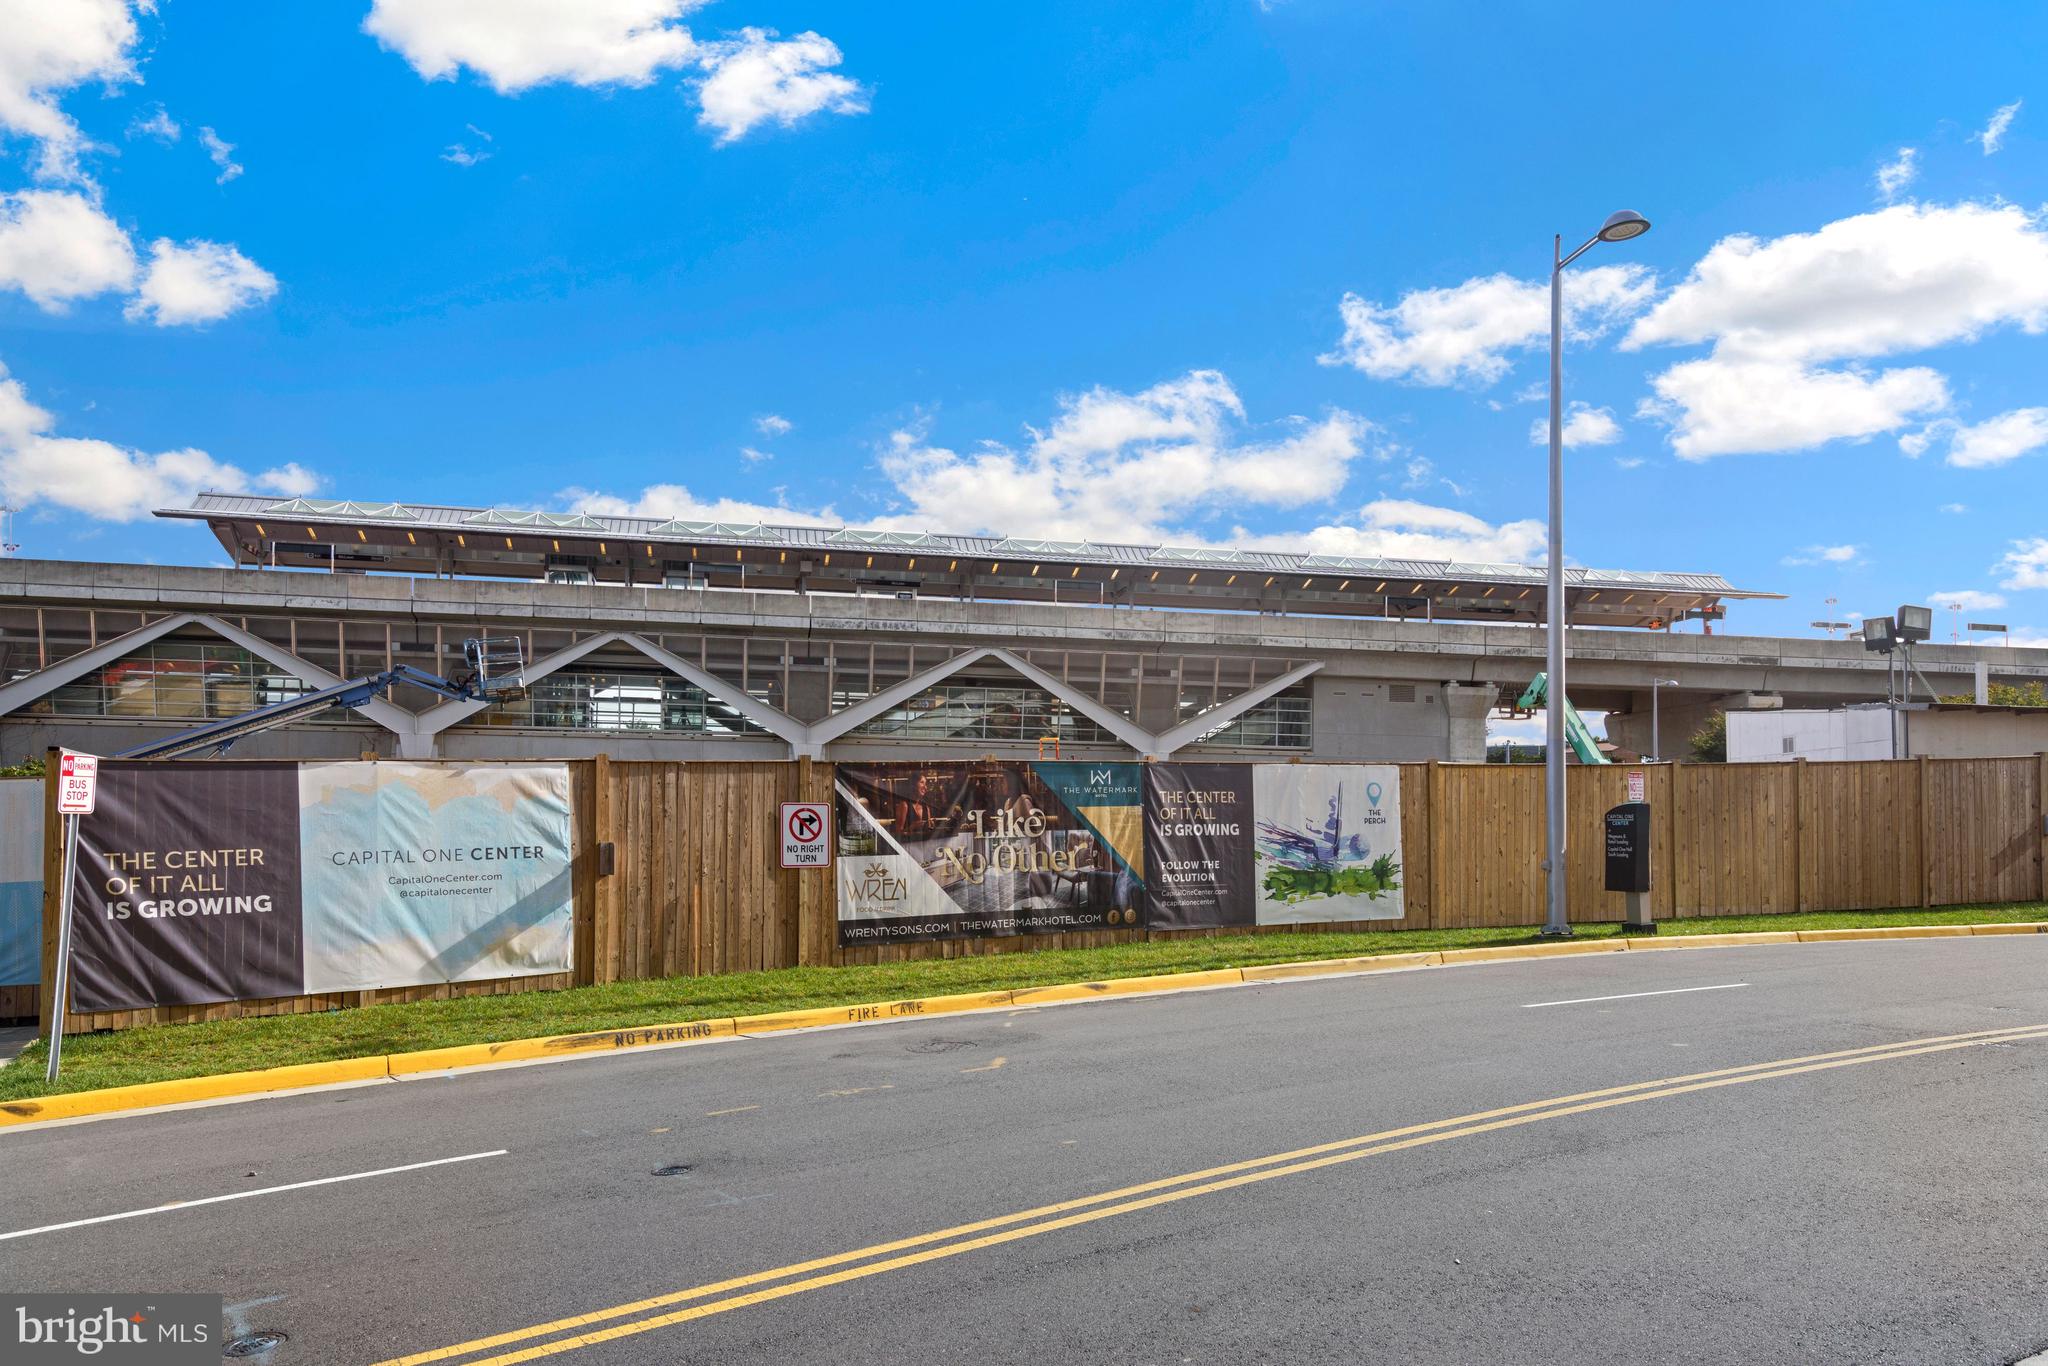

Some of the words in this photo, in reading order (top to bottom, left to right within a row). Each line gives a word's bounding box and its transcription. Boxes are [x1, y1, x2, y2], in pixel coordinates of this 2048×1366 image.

[63, 760, 74, 771] NO
[75, 763, 95, 771] PARKING
[69, 780, 87, 789] BUS
[1063, 786, 1080, 794] THE
[1084, 786, 1137, 794] WATERMARK
[66, 791, 88, 800] STOP
[1159, 791, 1183, 803] THE
[1186, 791, 1236, 803] CENTER
[1160, 808, 1177, 820] OF
[1180, 808, 1191, 820] IT
[1194, 808, 1216, 820] ALL
[967, 808, 1046, 839] Like
[1160, 824, 1172, 836] IS
[1174, 823, 1240, 836] GROWING
[786, 845, 799, 853] NO
[800, 845, 824, 853] RIGHT
[103, 852, 156, 871] THE
[164, 848, 264, 869] CENTER
[332, 850, 416, 866] CAPITAL
[422, 848, 464, 863] ONE
[470, 846, 545, 861] CENTER
[795, 855, 817, 863] TURN
[935, 845, 987, 885] No
[992, 841, 1089, 874] Other
[1161, 861, 1200, 870] FOLLOW
[1202, 860, 1220, 869] THE
[388, 873, 503, 886] CapitalOneCenter.com
[1162, 872, 1215, 883] EVOLUTION
[105, 876, 142, 896] OF
[150, 874, 173, 894] IT
[180, 874, 224, 892] ALL
[845, 878, 907, 902] WREN
[400, 886, 493, 900] @capitalonecenter
[1161, 889, 1228, 898] CapitalOneCenter.com
[106, 902, 131, 920] IS
[138, 894, 272, 919] GROWING
[1161, 899, 1216, 908] @capitalonecenter
[960, 914, 1101, 930] THEWATERMARKHOTEL.COM
[844, 923, 950, 938] WRENTYSONS.COM
[848, 1006, 880, 1022] FIRE
[890, 1001, 925, 1016] LANE
[615, 1032, 636, 1047] NO
[644, 1024, 712, 1043] PARKING
